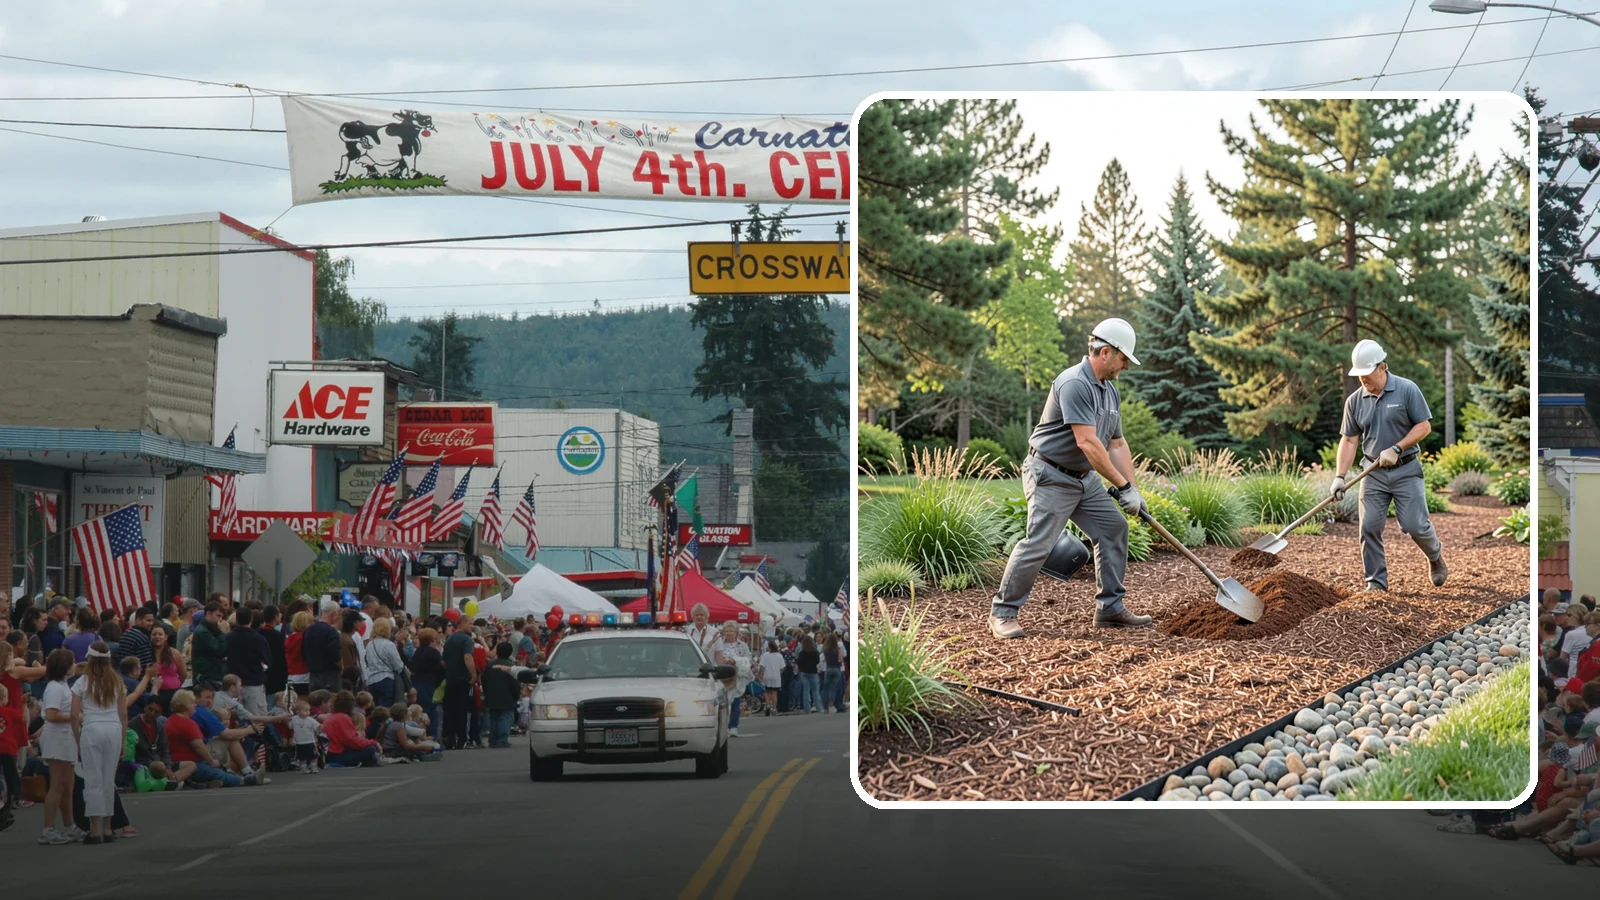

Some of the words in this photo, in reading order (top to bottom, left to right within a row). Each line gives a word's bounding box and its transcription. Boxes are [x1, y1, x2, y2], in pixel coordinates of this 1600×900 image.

[481, 140, 605, 192] JULY
[632, 150, 747, 198] 4th.
[696, 254, 850, 280] CROSSWA
[282, 380, 373, 420] ACE
[405, 409, 453, 421] CEDAR
[461, 409, 485, 421] LOG
[283, 421, 371, 436] Hardware
[416, 428, 477, 447] Coca-Cola
[353, 466, 387, 479] Simpl
[83, 486, 93, 494] St.
[96, 485, 124, 495] Vincent
[126, 486, 136, 495] de
[138, 486, 155, 495] Paul
[81, 503, 154, 522] THT
[212, 516, 331, 535] HARDARE
[688, 526, 741, 535] CRNATION
[699, 535, 730, 543] GLASS
